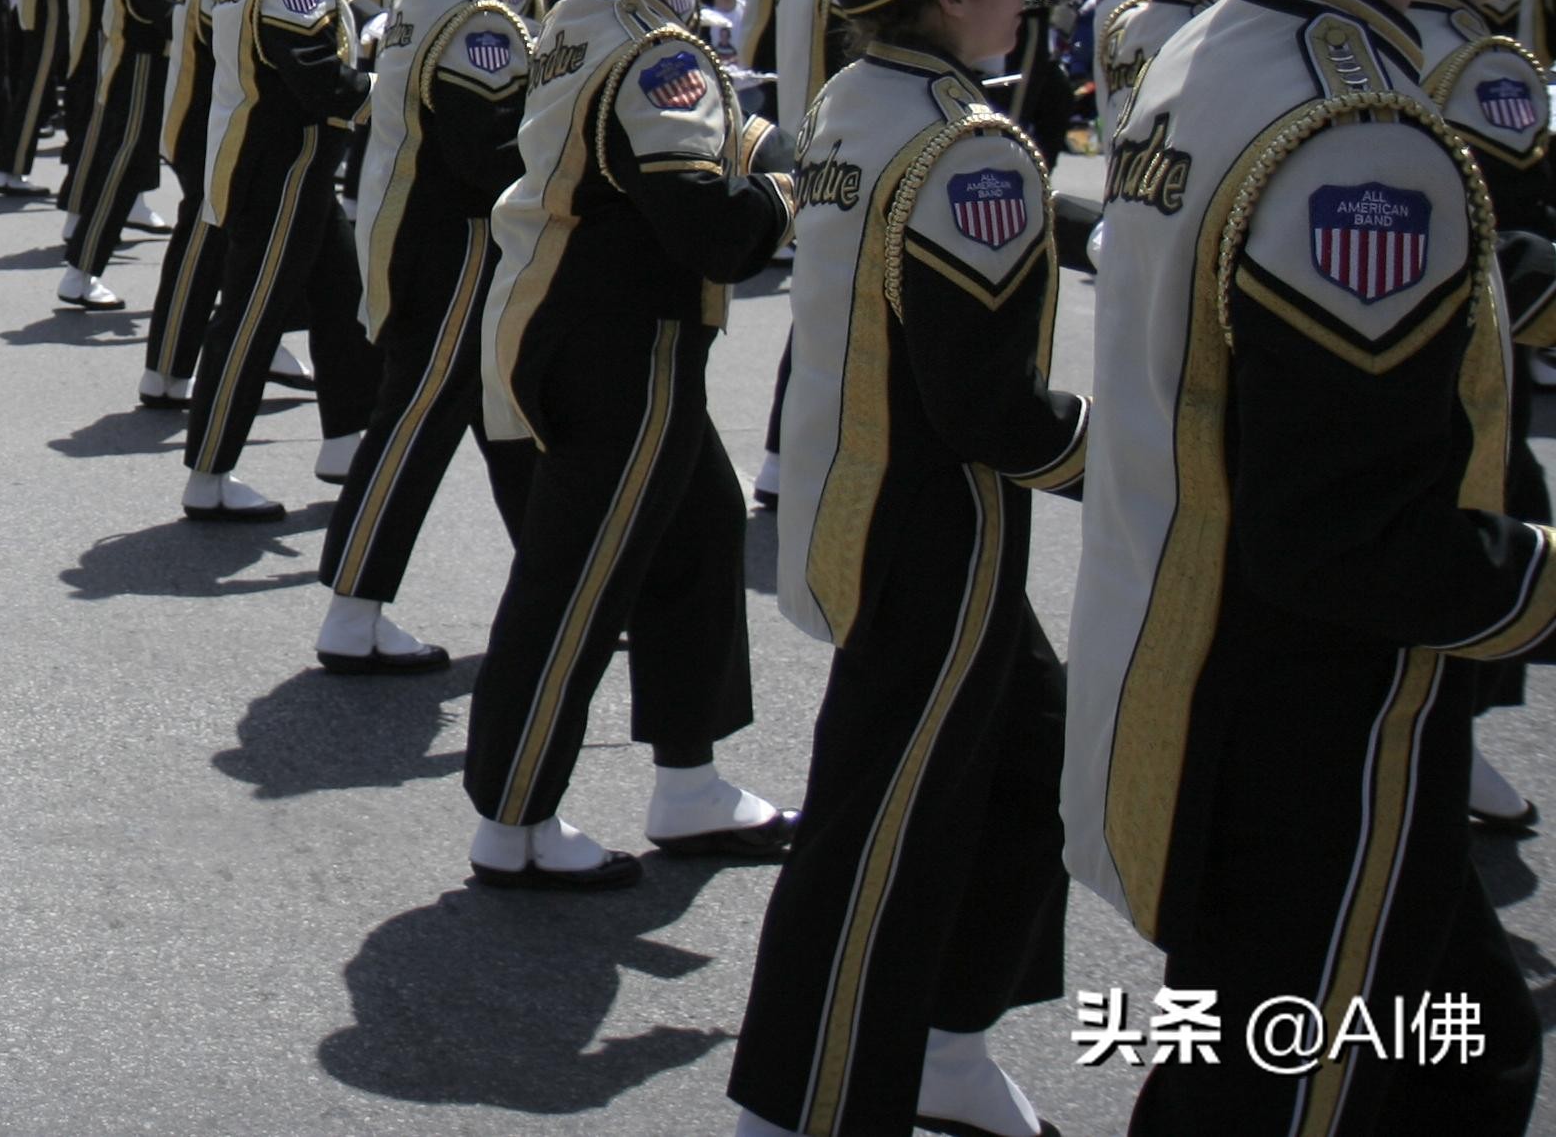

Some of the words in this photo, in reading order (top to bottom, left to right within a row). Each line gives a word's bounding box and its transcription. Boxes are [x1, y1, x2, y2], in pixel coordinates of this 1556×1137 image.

[1361, 190, 1387, 202] ALL
[1337, 201, 1409, 217] AMERICAN
[1354, 214, 1393, 227] BAND
